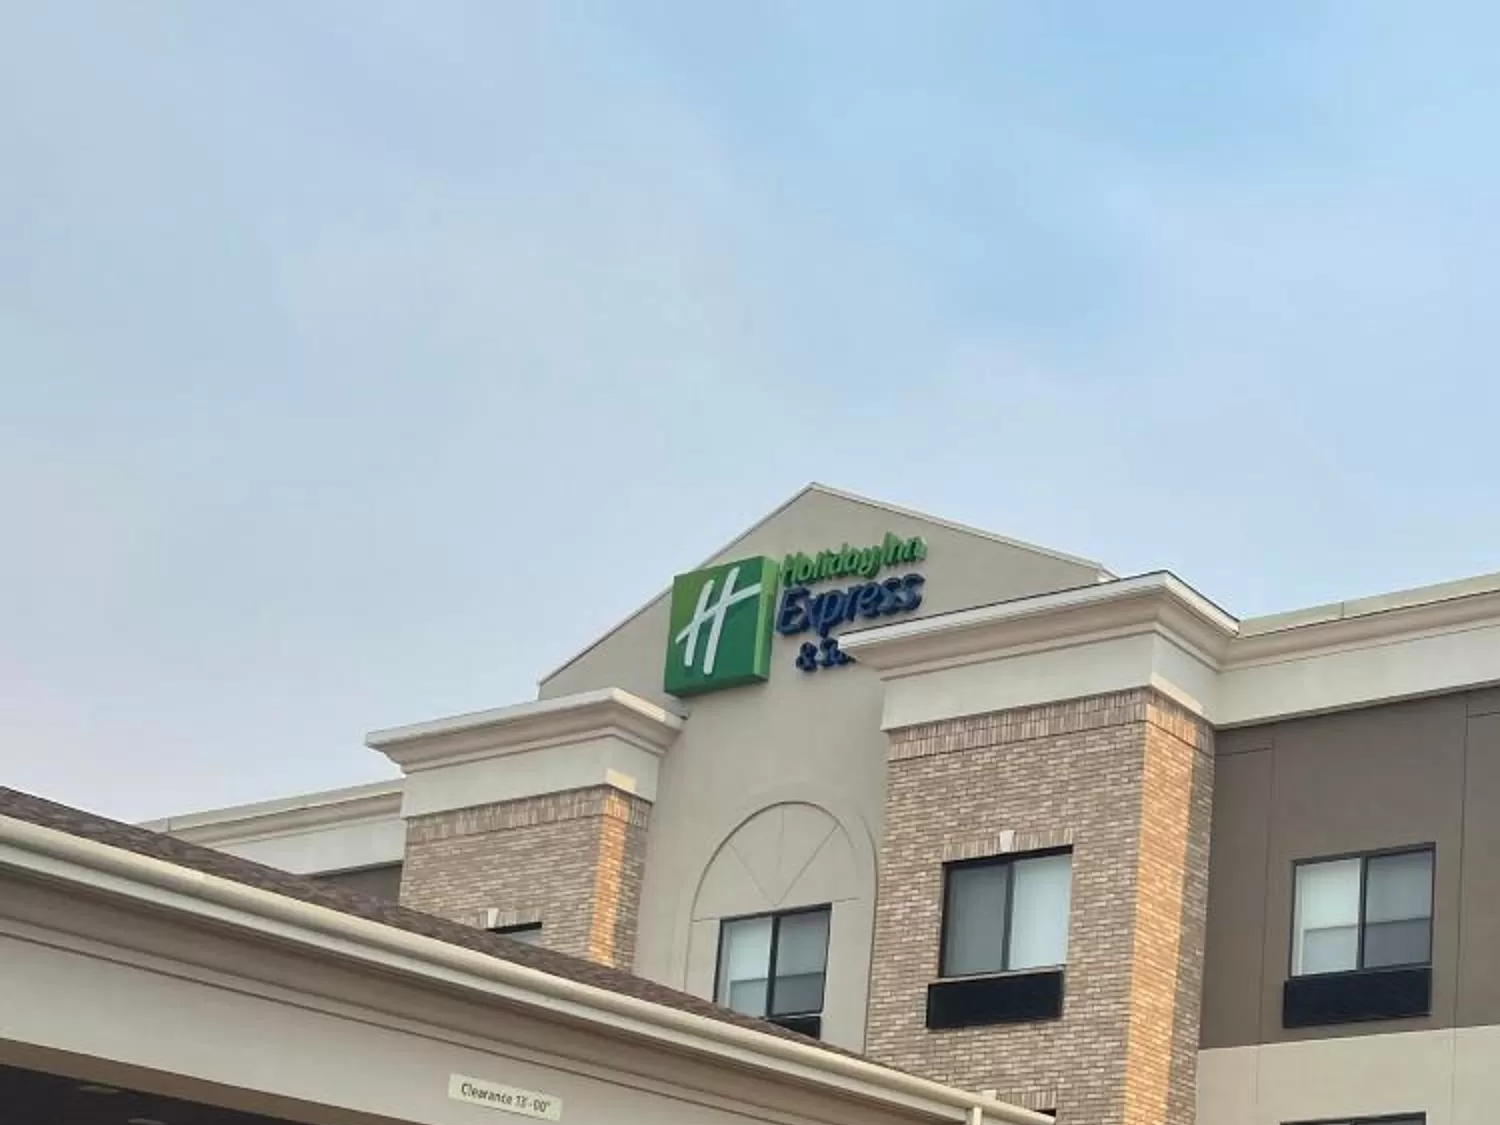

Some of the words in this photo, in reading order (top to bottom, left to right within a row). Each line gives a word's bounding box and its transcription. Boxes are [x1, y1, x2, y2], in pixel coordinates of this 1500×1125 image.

[780, 541, 883, 587] Holiday
[880, 531, 928, 566] Inn
[776, 573, 926, 638] Express
[461, 1082, 513, 1106] Clearance
